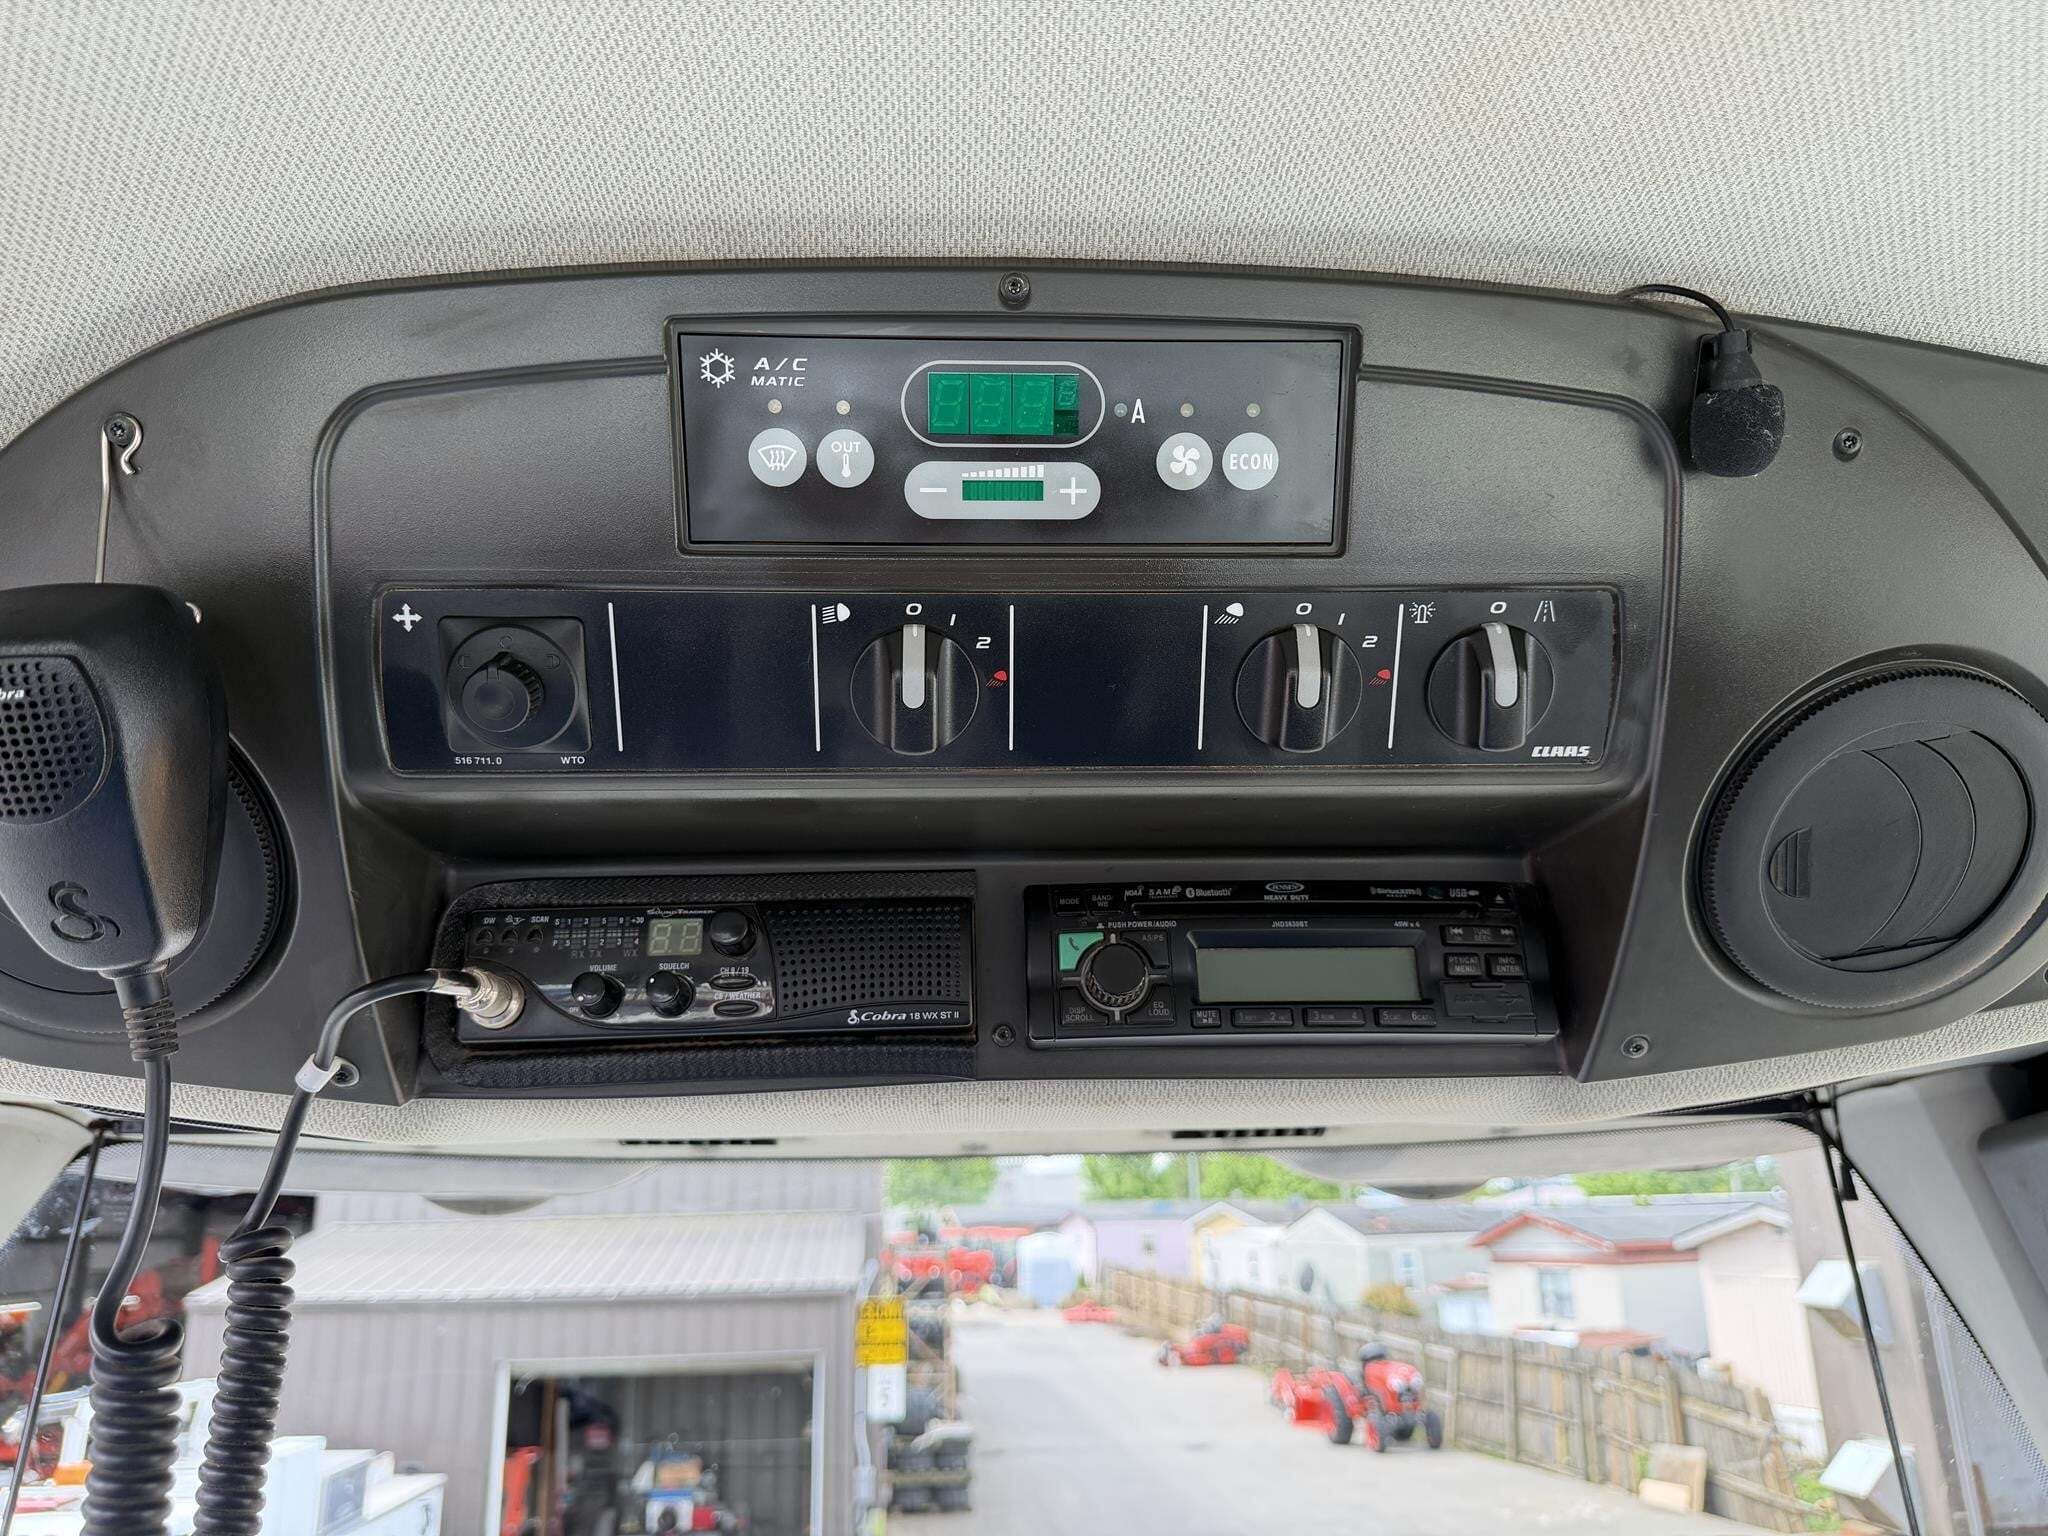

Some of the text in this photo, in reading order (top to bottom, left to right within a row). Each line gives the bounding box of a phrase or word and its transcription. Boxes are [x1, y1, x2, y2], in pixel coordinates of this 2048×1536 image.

[754, 357, 808, 371] A/C
[751, 376, 805, 387] MATIC
[1131, 398, 1146, 424] A
[831, 441, 861, 453] OUT
[1229, 453, 1273, 470] ECON
[1490, 601, 1507, 614] 0
[905, 603, 923, 616] 0
[975, 636, 992, 649] 2
[1295, 602, 1313, 615] 0
[1362, 635, 1378, 648] 2
[1531, 745, 1592, 758] CLAAS
[455, 756, 472, 765] 516
[560, 756, 586, 765] WTO
[1195, 888, 1232, 897] Bluetooth
[1059, 897, 1081, 905] MODE
[531, 915, 550, 924] SCAN
[1107, 921, 1127, 929] PUSH
[589, 963, 618, 972] VOLUME
[658, 962, 690, 970] SQUELCH
[860, 1010, 907, 1021] Cobra
[909, 1012, 921, 1020] 18
[923, 1012, 939, 1020] WX
[940, 1011, 952, 1019] ST
[1148, 1008, 1170, 1016] LOUD
[1196, 1010, 1217, 1018] MUTE
[1065, 1014, 1094, 1022] SCROLL
